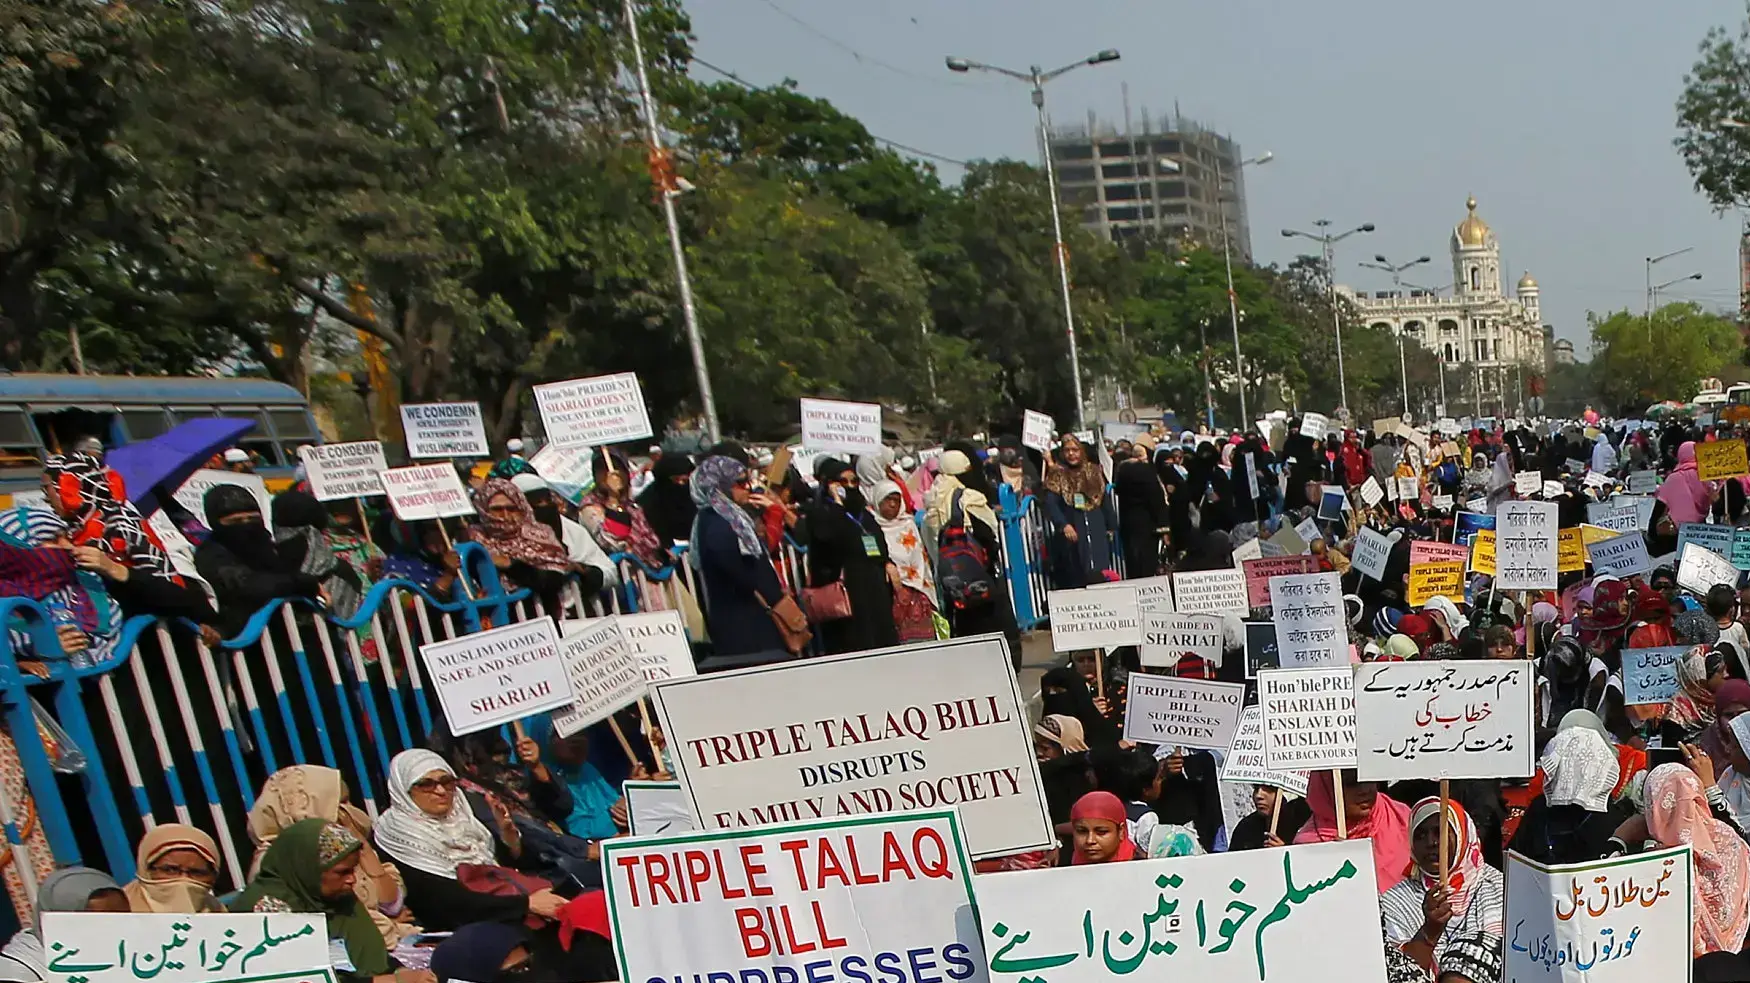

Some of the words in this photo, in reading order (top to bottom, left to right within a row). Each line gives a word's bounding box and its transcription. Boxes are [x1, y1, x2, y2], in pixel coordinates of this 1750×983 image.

[405, 408, 421, 420] WE
[425, 407, 476, 418] CONDEMN
[307, 449, 325, 460] WE
[328, 444, 379, 458] CONDEMN
[1357, 555, 1377, 570] PRIDE
[1592, 540, 1640, 559] SHARIAH
[1426, 575, 1448, 583] AGAINST
[1182, 602, 1214, 611] MUSLIM
[627, 622, 678, 639] TALAQ
[1056, 623, 1087, 633] TRIPLE
[1089, 621, 1118, 631] TALAQ
[1119, 619, 1138, 629] BILL
[1150, 621, 1169, 629] WE
[1172, 621, 1200, 630] ABIDE
[1202, 622, 1216, 630] BY
[436, 642, 495, 668] MUSLIM
[496, 631, 547, 654] WOMEN
[1146, 633, 1219, 647] SHARIAT
[439, 666, 474, 685] SAFE
[478, 657, 504, 676] AND
[507, 643, 556, 668] SECURE
[497, 674, 513, 687] IN
[1363, 666, 1394, 692] کے
[470, 681, 552, 716] SHARIAH
[1135, 685, 1188, 699] TRIPLE
[1191, 690, 1239, 705] TALAQ
[1169, 701, 1202, 714] BILL
[1268, 697, 1338, 714] SHARIAH
[1147, 711, 1221, 726] SUPPRESSES
[1268, 715, 1333, 731] ENSLAVE
[1415, 695, 1440, 727] کی
[1436, 702, 1492, 728] خطاب
[687, 723, 813, 769] TRIPLE
[814, 706, 931, 749] TALAQ
[932, 695, 1012, 732] BILL
[1152, 724, 1215, 738] WOMEN
[1273, 730, 1338, 747] MUSLIM
[798, 749, 927, 788] DISRUPTS
[1270, 751, 1294, 762] TAKE
[1296, 751, 1321, 761] BACK
[1322, 749, 1348, 759] YOUR
[835, 787, 893, 817] AND
[898, 766, 1023, 812] SOCIETY
[617, 844, 774, 908] TRIPLE
[780, 827, 954, 892] TALAQ
[1639, 859, 1675, 907] تین
[1556, 876, 1585, 920] بل
[1587, 876, 1640, 917] طلاق
[1102, 873, 1258, 975] خواتین
[1255, 850, 1358, 982] مسلم
[734, 900, 848, 959] BILL
[1511, 919, 1528, 951] کے
[131, 920, 243, 979] خواتین
[241, 915, 315, 974] مسلم
[1575, 926, 1642, 971] عورتوں
